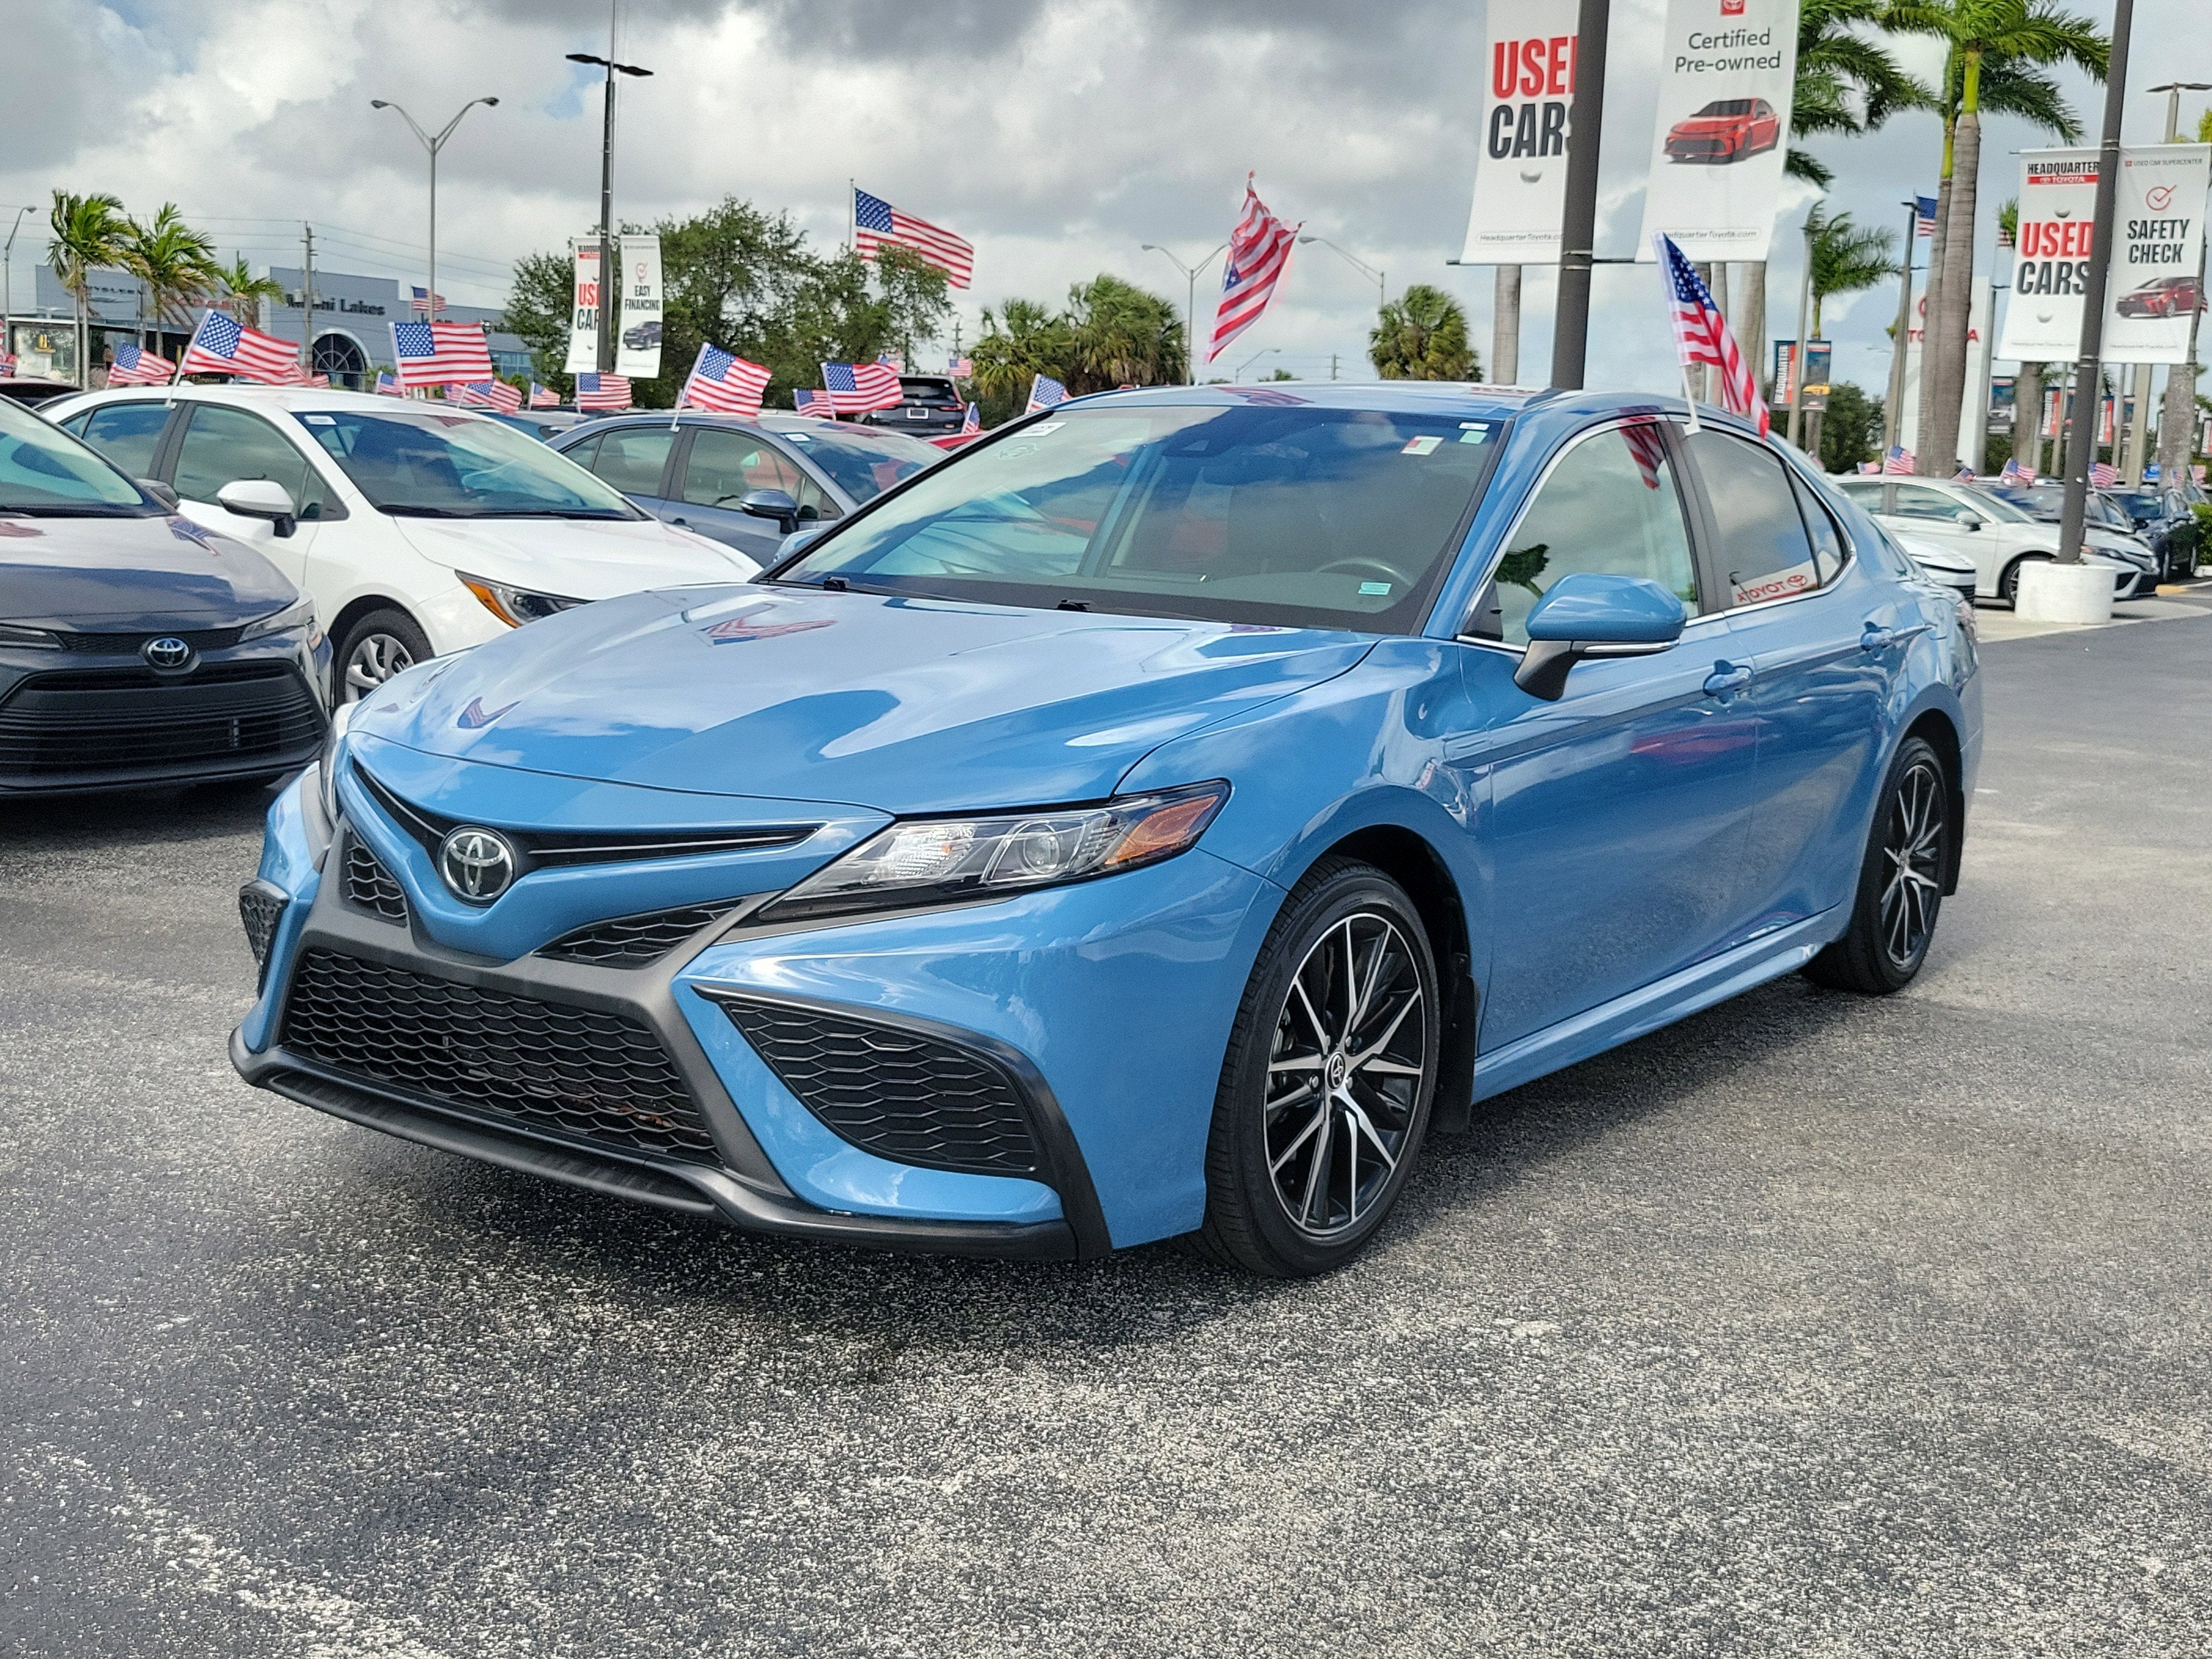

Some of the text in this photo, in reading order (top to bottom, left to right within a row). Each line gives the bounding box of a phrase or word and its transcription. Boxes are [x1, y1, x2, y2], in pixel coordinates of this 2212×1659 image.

[1689, 27, 1770, 49] Certified
[1675, 50, 1781, 73] Pre-owned
[1488, 102, 1572, 159] CAR
[2028, 162, 2099, 174] HEADQUARTER
[2023, 222, 2093, 257] USED
[2128, 219, 2190, 239] SAFETY
[2129, 244, 2183, 263] CHECK
[2017, 261, 2090, 295] CARS
[579, 284, 600, 306] US
[635, 285, 650, 297] EASY
[341, 298, 385, 315] Lakes
[625, 299, 660, 311] FINANCING
